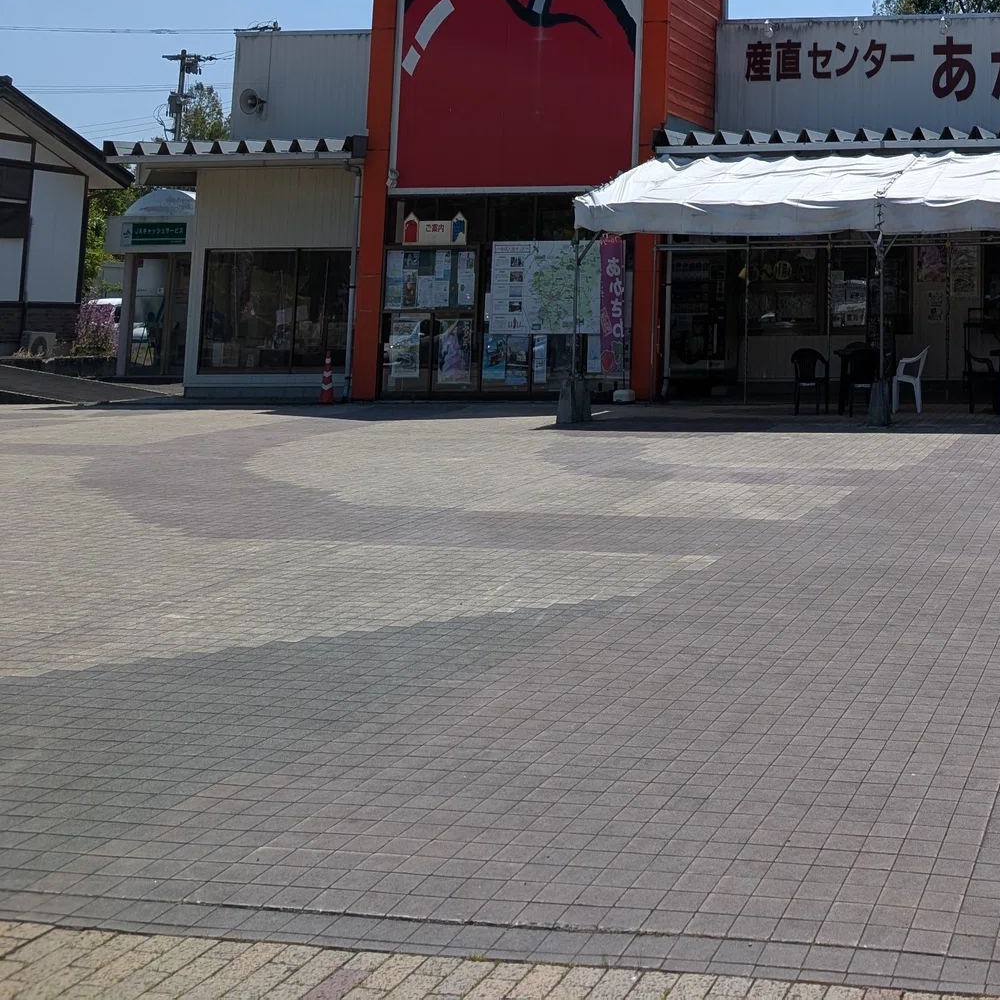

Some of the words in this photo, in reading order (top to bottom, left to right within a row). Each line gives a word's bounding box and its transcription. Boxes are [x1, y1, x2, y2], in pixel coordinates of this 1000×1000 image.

[744, 39, 915, 83] 産直センター
[425, 223, 445, 233] ご案内
